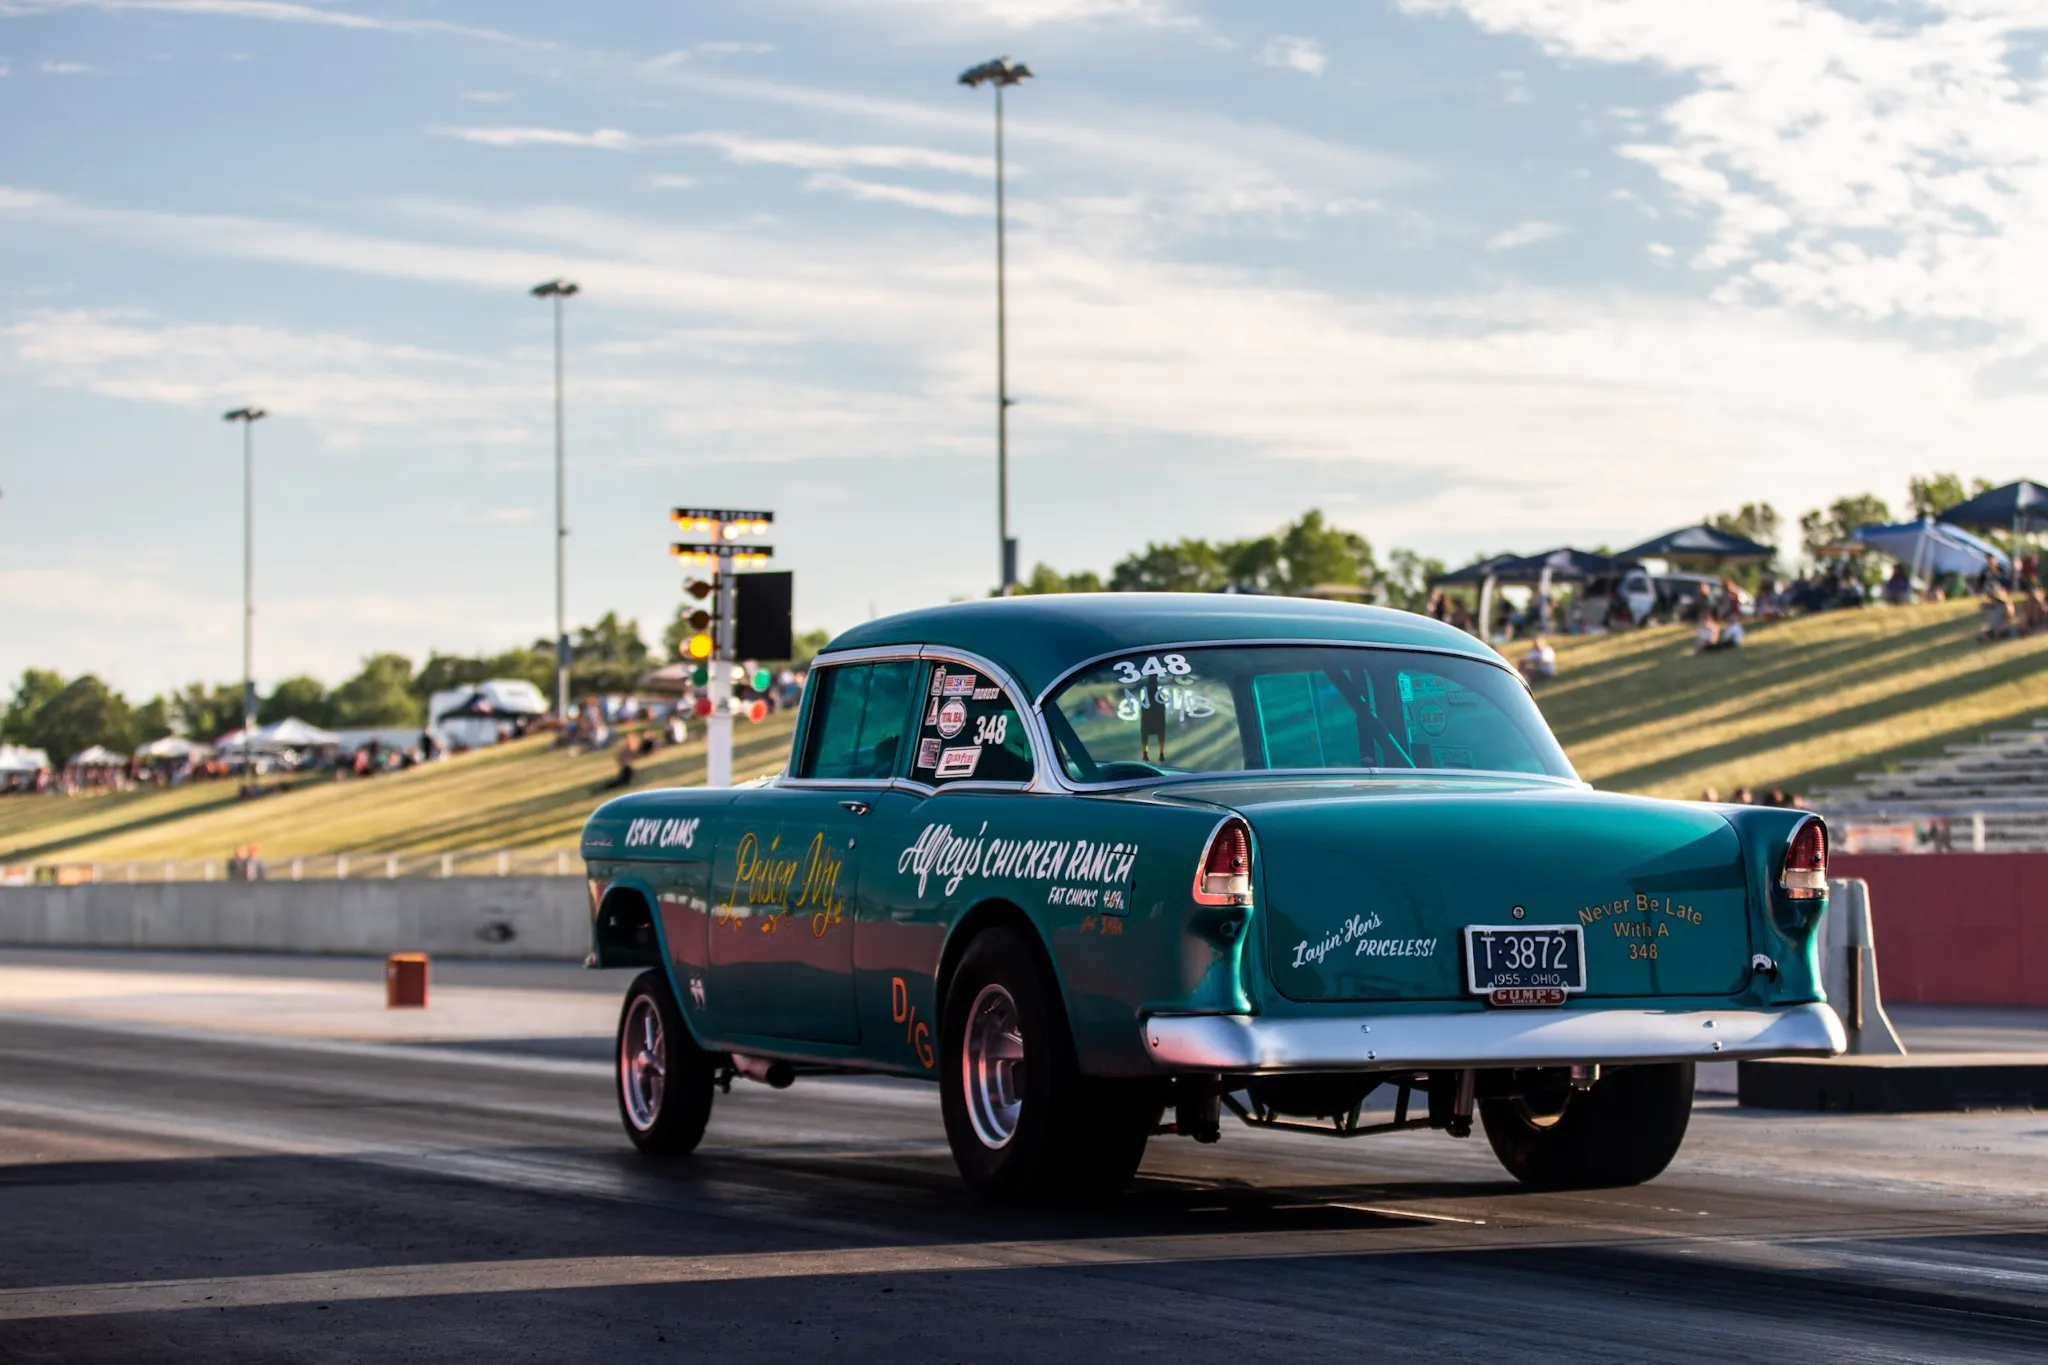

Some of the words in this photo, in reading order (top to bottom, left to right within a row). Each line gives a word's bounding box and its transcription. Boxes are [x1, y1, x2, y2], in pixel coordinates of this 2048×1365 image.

[1112, 653, 1192, 684] 348
[973, 715, 1008, 745] 348
[625, 818, 662, 848] ISKY
[660, 817, 700, 849] CAMS
[982, 838, 1070, 880] CHICKEN
[1065, 839, 1138, 884] RANCH
[1047, 886, 1067, 905] FAT
[1065, 888, 1098, 908] CHICKS
[1578, 898, 1630, 928] Never
[1636, 893, 1659, 912] Be
[1665, 897, 1703, 925] Late
[1344, 911, 1383, 943] Hen's
[1613, 921, 1653, 938] With
[1657, 922, 1670, 937] A
[1355, 938, 1437, 957] PRICELESS!
[1628, 943, 1658, 960] 348
[1494, 973, 1521, 986] 1955
[1530, 973, 1560, 986] OHIO
[1497, 989, 1562, 1001] GUMP'S
[892, 976, 935, 1069] D/G
